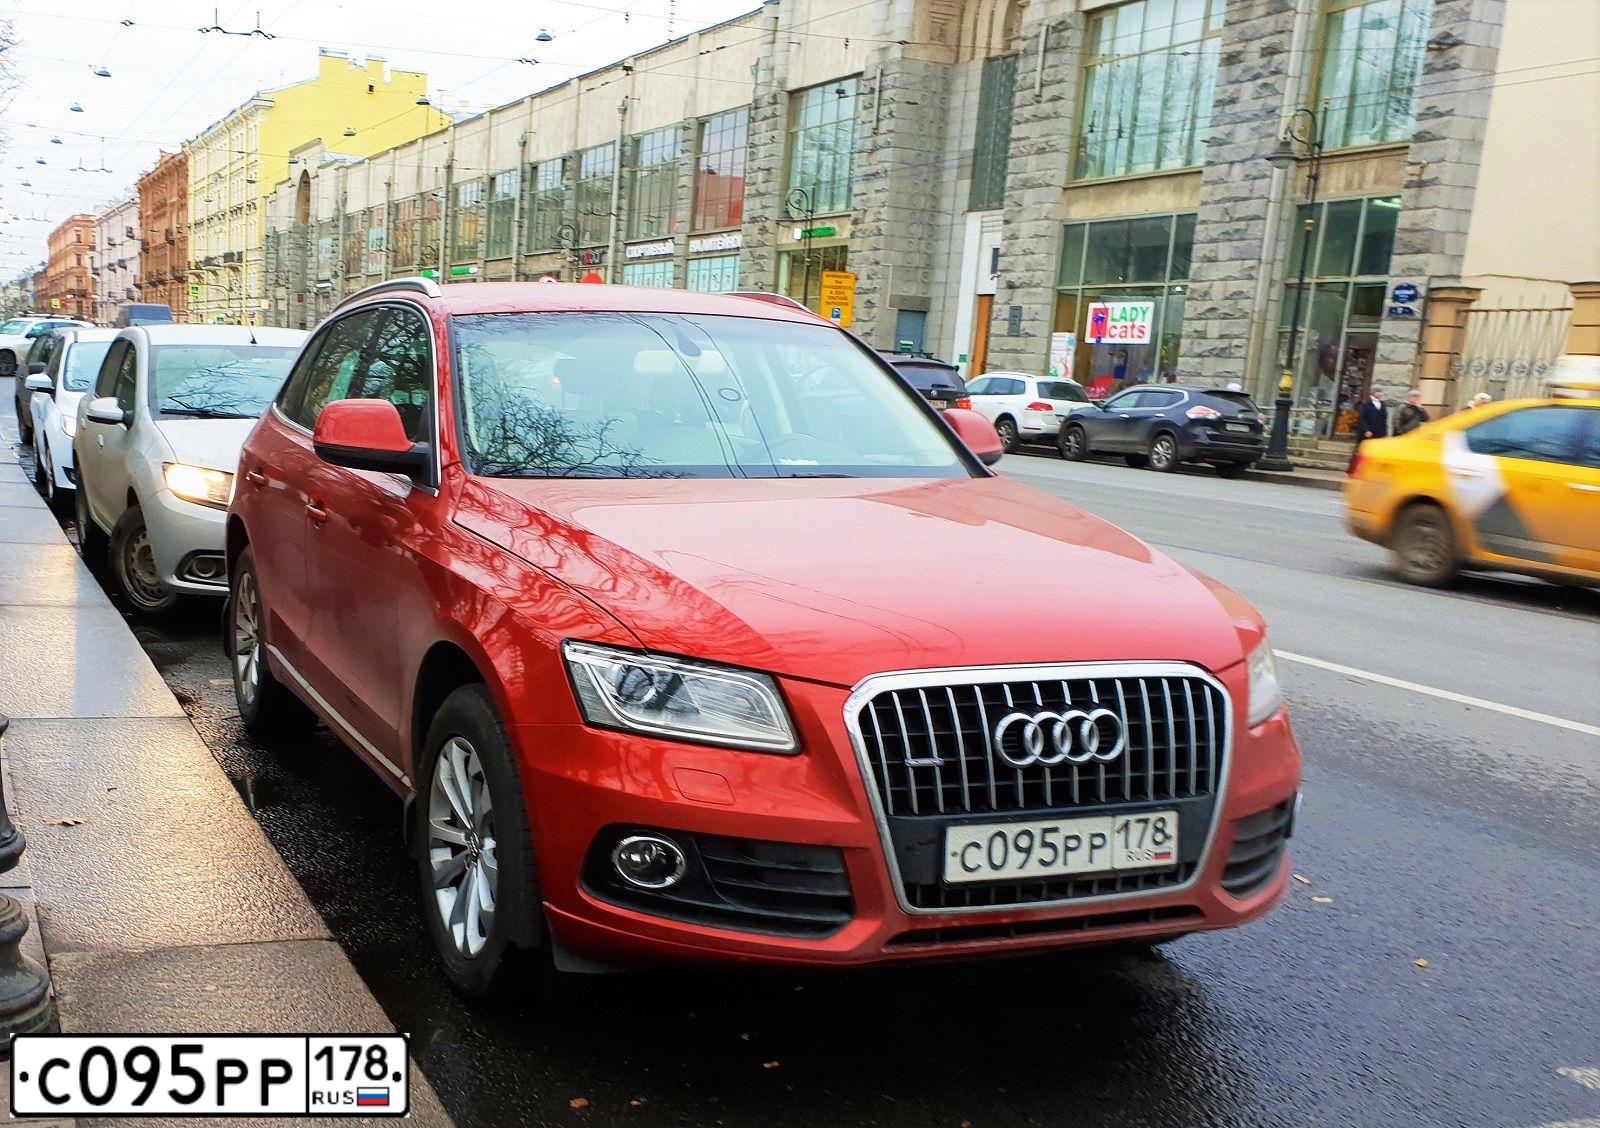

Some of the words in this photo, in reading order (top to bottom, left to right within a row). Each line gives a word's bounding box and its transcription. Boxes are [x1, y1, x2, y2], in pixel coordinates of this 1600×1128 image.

[1110, 306, 1150, 322] LADY
[1108, 321, 1146, 338] cats
[1116, 816, 1172, 850] 178
